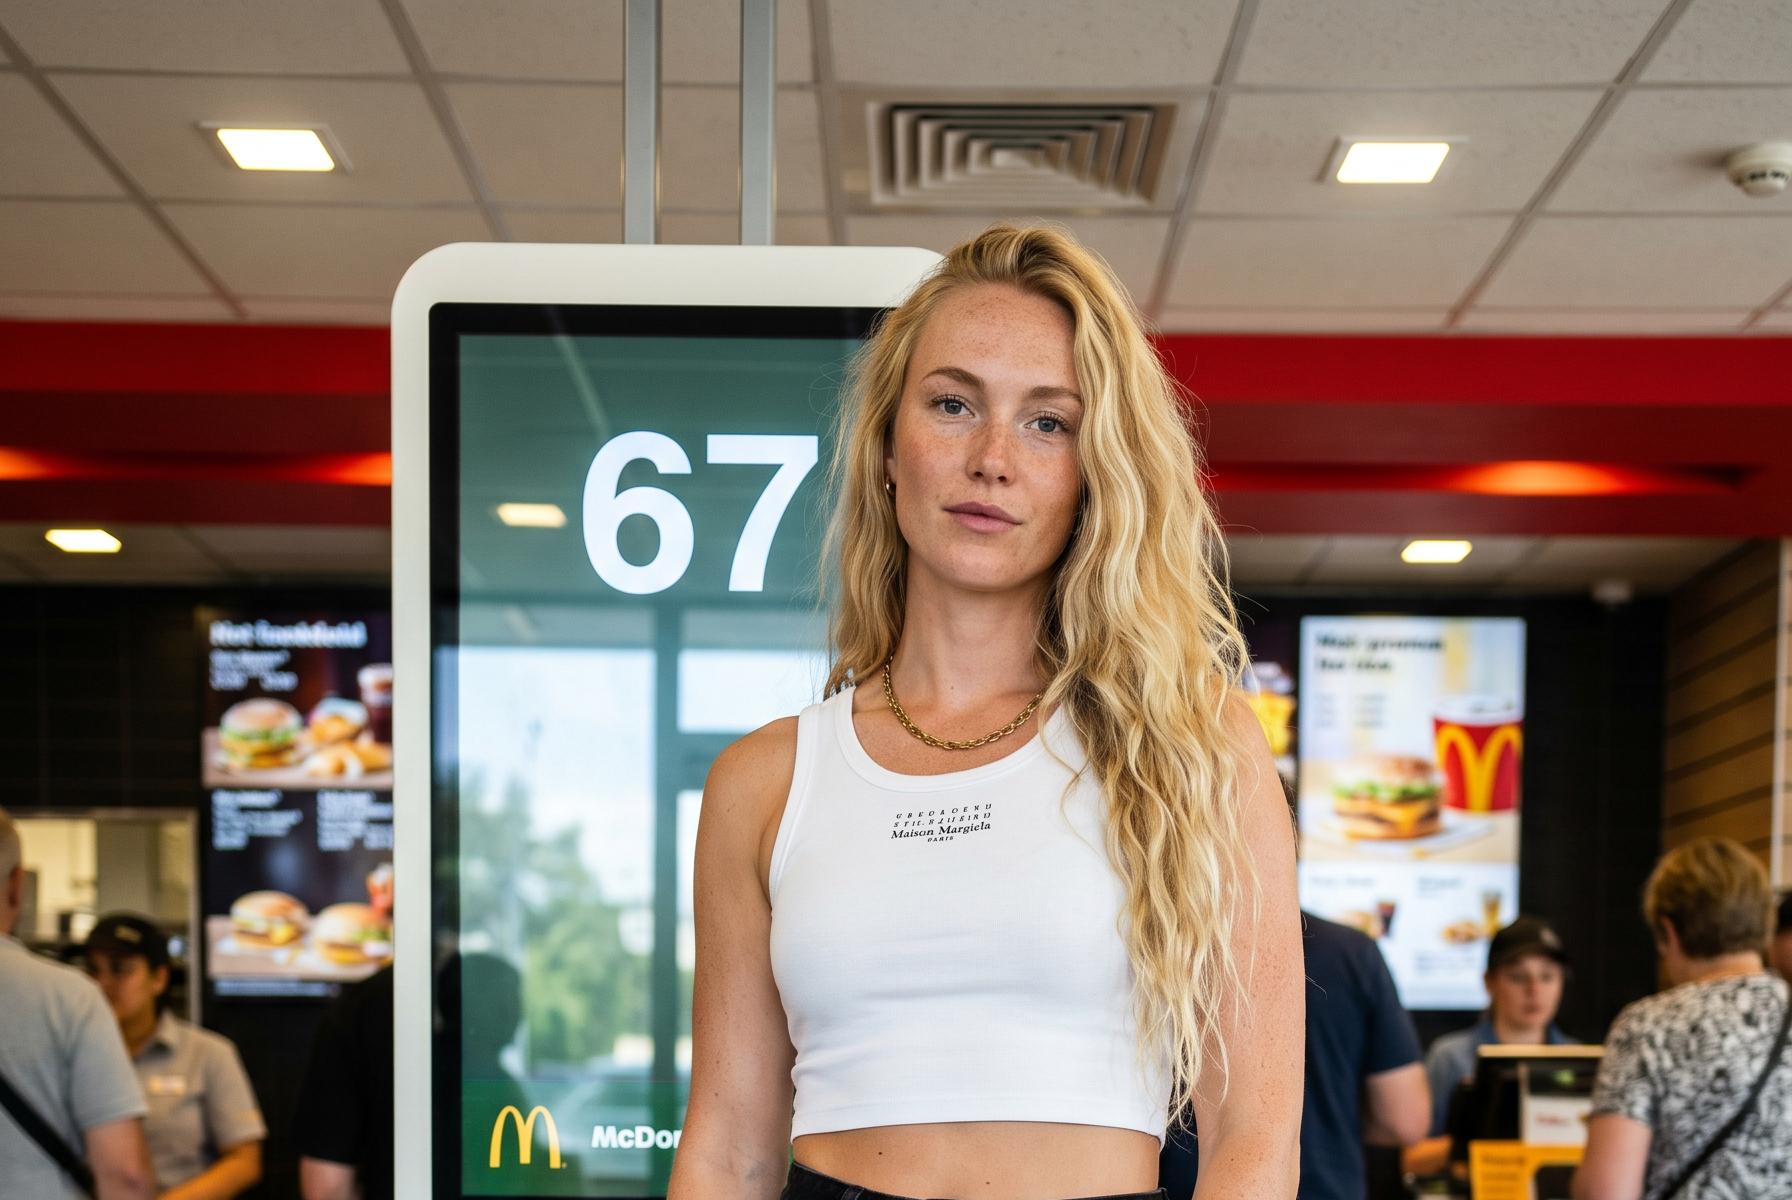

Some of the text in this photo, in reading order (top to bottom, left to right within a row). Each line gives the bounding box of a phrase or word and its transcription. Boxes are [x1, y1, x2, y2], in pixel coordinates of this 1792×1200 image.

[582, 430, 819, 595] 67
[891, 821, 991, 839] Maison Margiela
